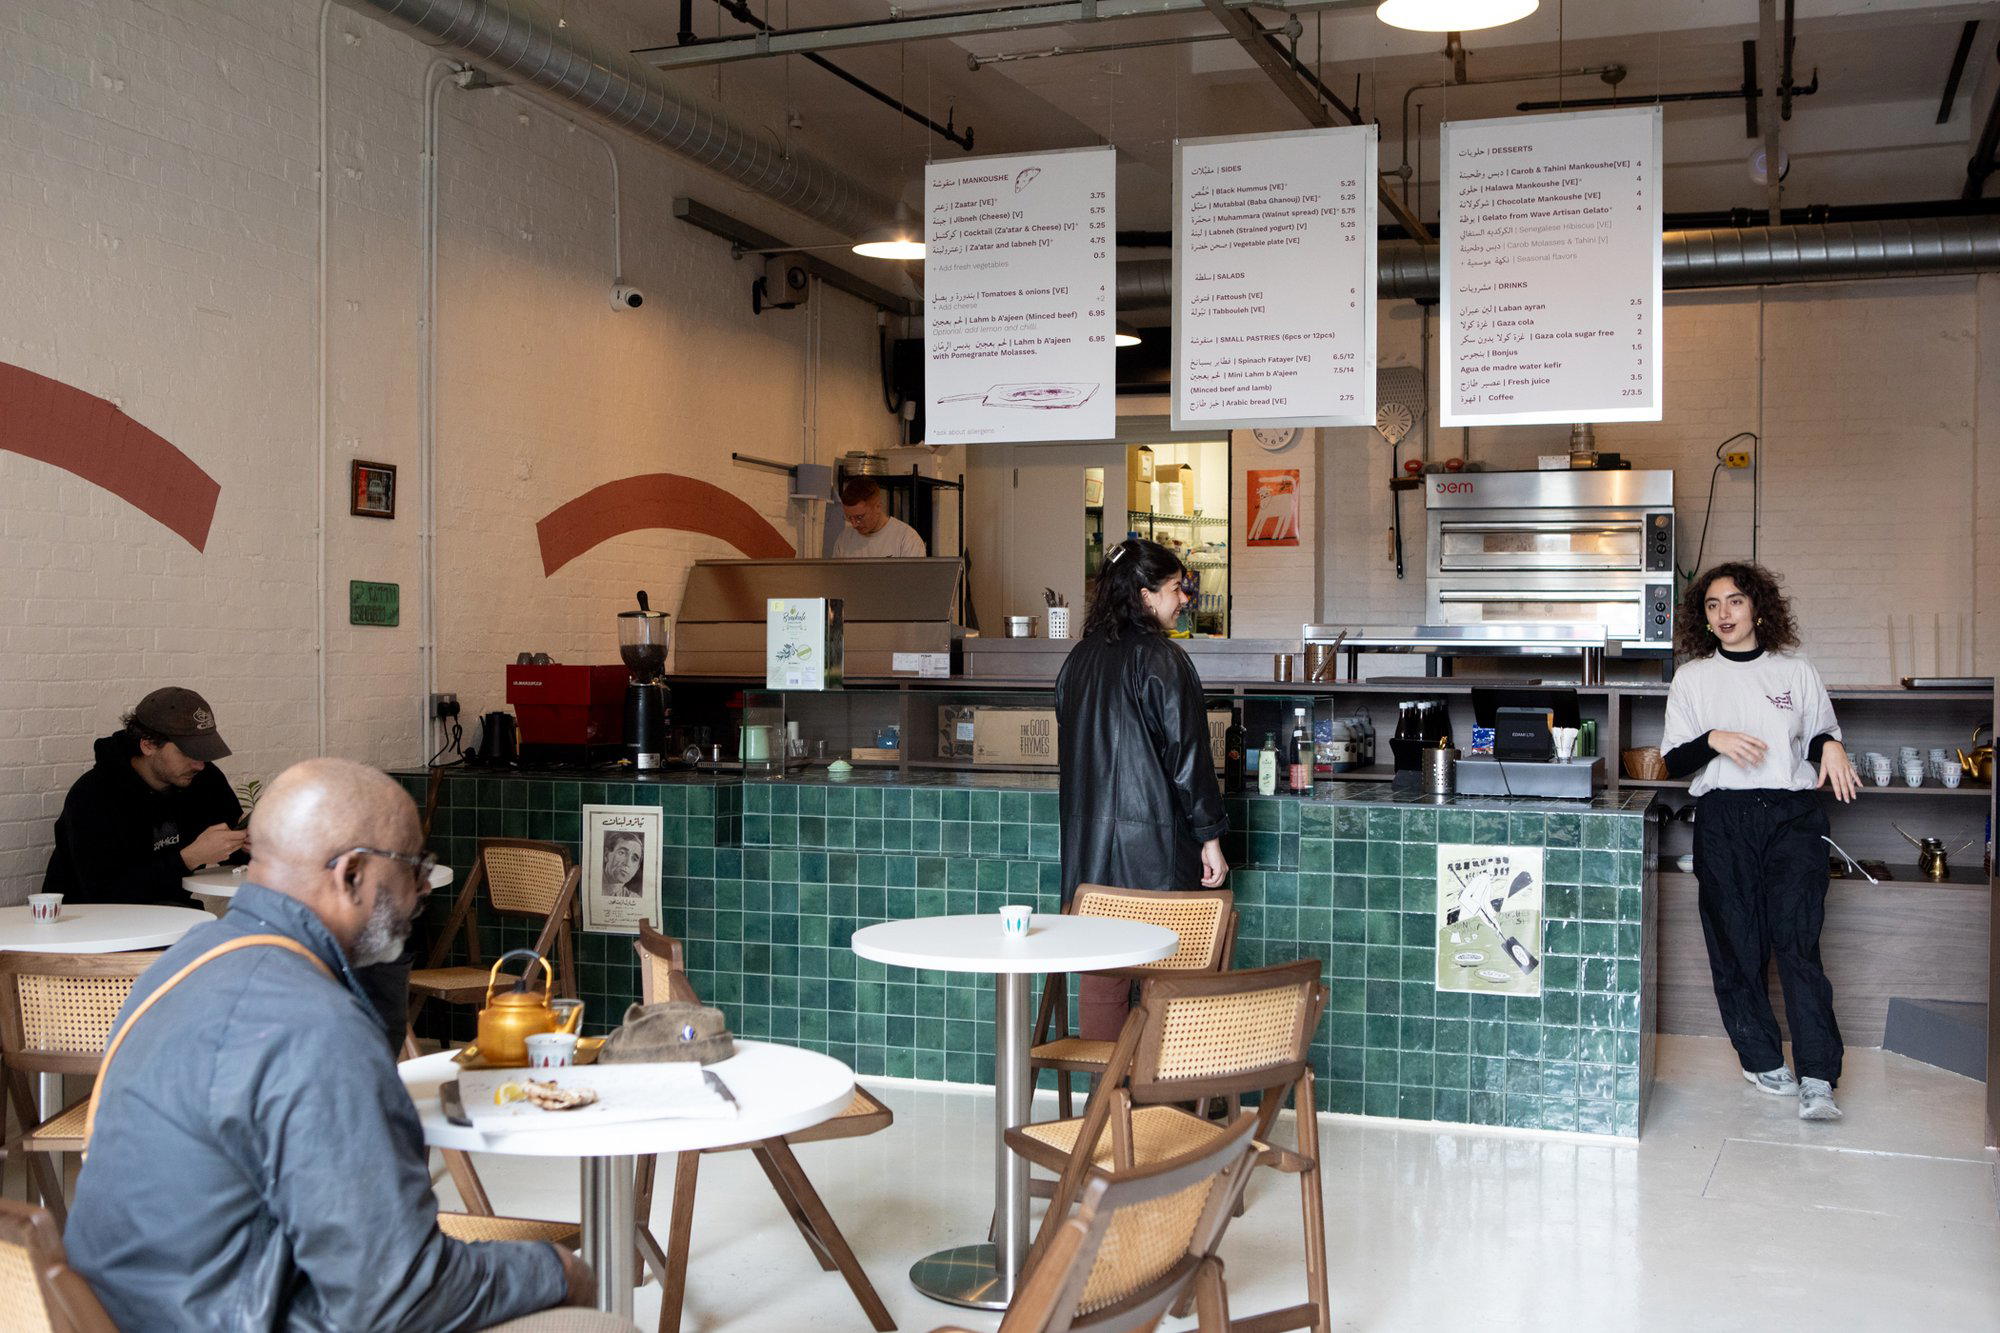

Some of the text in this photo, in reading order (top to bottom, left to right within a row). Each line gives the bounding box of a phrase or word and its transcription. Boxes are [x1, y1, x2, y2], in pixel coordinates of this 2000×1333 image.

[1492, 145, 1533, 154] DESSERTS
[1221, 165, 1241, 173] SIDES
[1511, 167, 1534, 175] Carob
[1543, 164, 1566, 172] Tahini
[962, 174, 1008, 184] MANKOUSHE
[1516, 180, 1560, 189] Mankoushe
[1216, 187, 1235, 195] Black
[1237, 185, 1267, 193] Hummus
[1213, 200, 1245, 208] Mutabbal
[1247, 198, 1267, 206] (Baba
[1268, 196, 1300, 204] Ghanouj)
[1496, 197, 1535, 205] Chocolate
[1538, 194, 1582, 202] Mankoushe
[1584, 192, 1601, 200] [VE]
[954, 215, 977, 223] Jibneh
[979, 212, 1010, 222] (Cheese)
[1012, 211, 1023, 219] [V]
[1262, 211, 1289, 219] (Walnut
[1292, 208, 1319, 217] spread)
[1236, 225, 1268, 235] (Strained
[1269, 224, 1295, 233] yogurt)
[1297, 222, 1307, 231] [V]
[1597, 220, 1612, 229] [VE]
[963, 228, 993, 237] Cocktail
[996, 241, 1009, 249] and
[1011, 240, 1037, 248] labneh
[1233, 240, 1265, 248] Vegetable
[1285, 237, 1300, 245] [VE]
[1507, 240, 1529, 249] Carob
[1574, 236, 1596, 244] Tahini
[1597, 234, 1608, 244] [V]
[1517, 252, 1577, 262] Seasonal flavors
[939, 264, 953, 272] Add
[954, 263, 971, 271] fresh
[973, 261, 1009, 271] vegetables
[1217, 272, 1245, 280] SALADS
[981, 290, 1016, 298] Tomatoes
[1052, 286, 1068, 295] [VE]
[1248, 292, 1263, 300] [VE]
[938, 301, 978, 311] Add cheese
[1212, 306, 1249, 314] Tabbouleh
[1251, 305, 1265, 314] [VE]
[1524, 304, 1545, 312] ayran
[1026, 312, 1055, 321] (Minced
[1058, 311, 1077, 319] beef)
[1313, 332, 1335, 340] 12pcs)
[1556, 331, 1572, 339] cola
[1044, 337, 1071, 345] A'ajeen
[951, 351, 998, 359] Pomegranate
[1492, 349, 1518, 357] Bonjus
[1238, 357, 1266, 365] Spinach
[1296, 355, 1311, 363] [VE]
[1531, 378, 1550, 386] juice
[1190, 386, 1218, 394] (Minced
[1272, 398, 1287, 406] [VE]
[1436, 482, 1473, 493] oem
[1021, 719, 1050, 736] THE GOOD
[1210, 721, 1225, 739] OOD
[1020, 736, 1050, 754] THYMES
